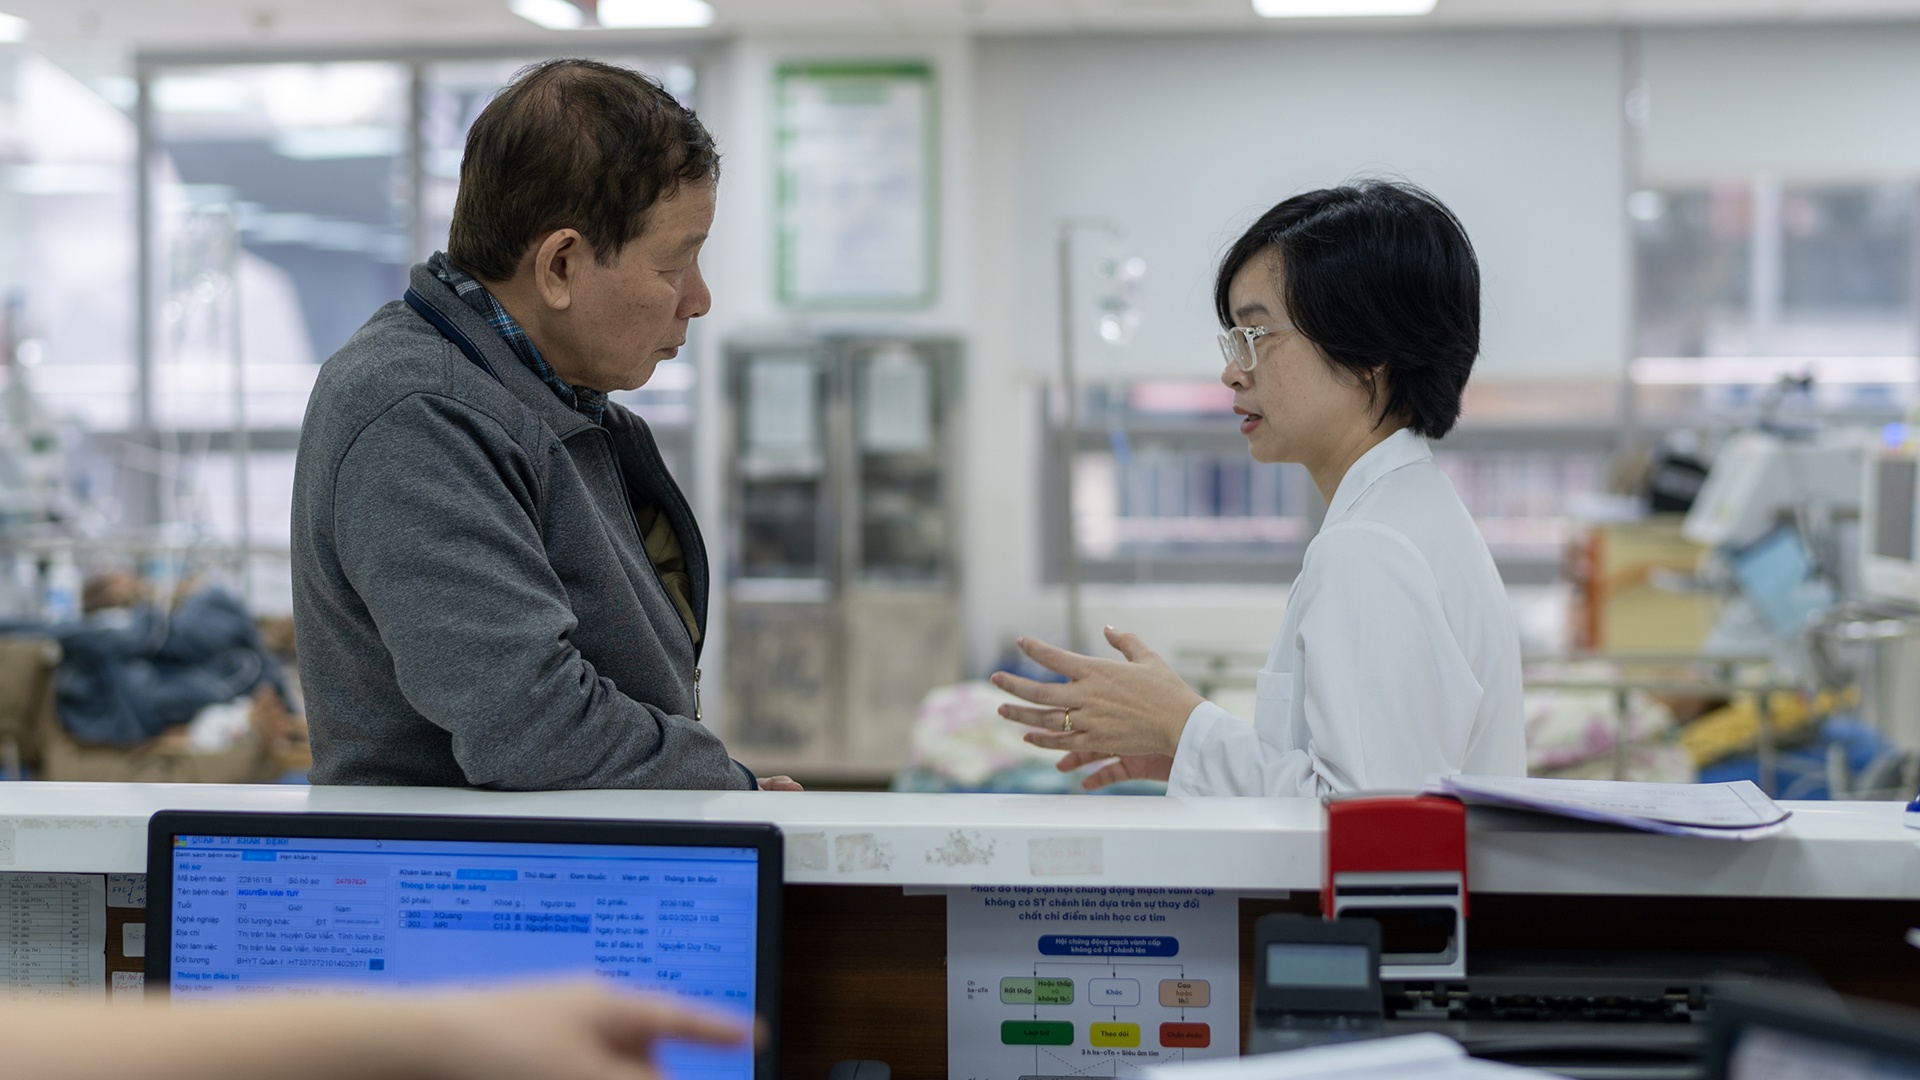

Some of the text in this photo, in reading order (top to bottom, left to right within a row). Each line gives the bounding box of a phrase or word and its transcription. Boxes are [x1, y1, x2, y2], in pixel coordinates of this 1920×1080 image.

[984, 897, 1200, 910] không có ST chênh lên dựa trên sự thay đổi
[1019, 910, 1166, 923] chất chỉ điểm sinh học cơ tim
[1071, 946, 1092, 954] không
